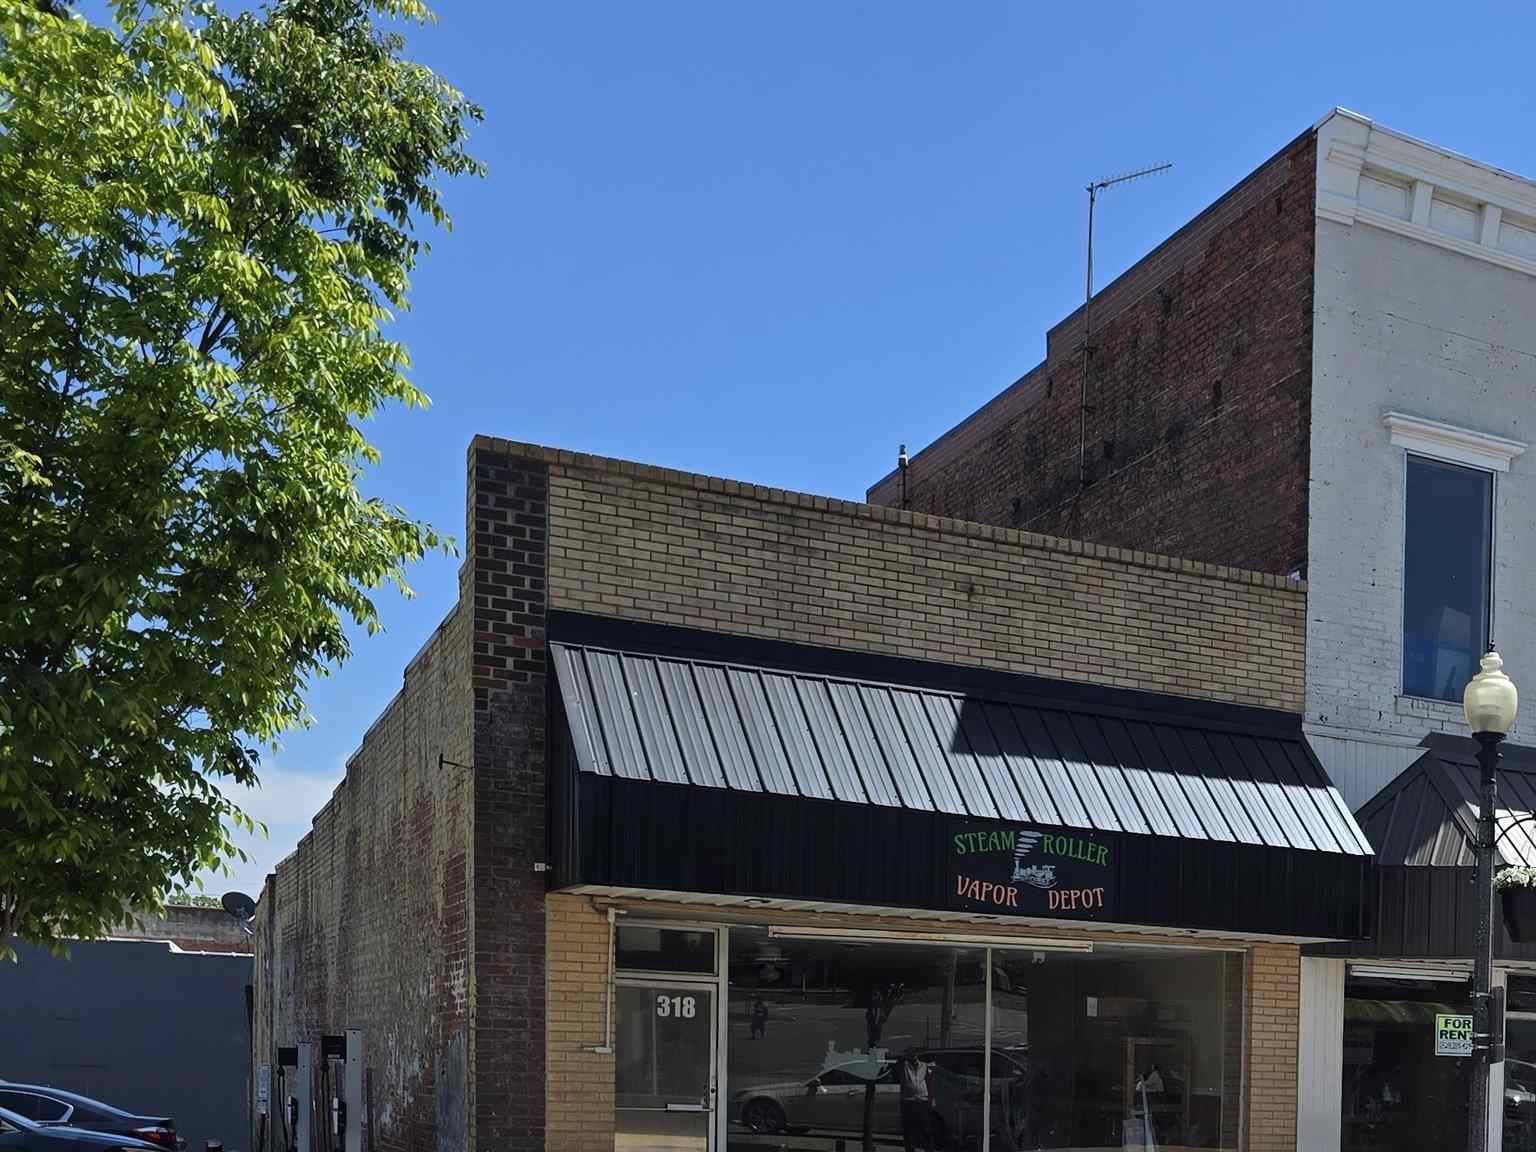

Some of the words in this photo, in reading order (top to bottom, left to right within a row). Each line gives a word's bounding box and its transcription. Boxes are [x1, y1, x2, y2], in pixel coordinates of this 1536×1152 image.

[954, 830, 1016, 855] STEAM
[1042, 834, 1109, 867] ROLLER
[956, 874, 1018, 907] VAPOR
[1048, 887, 1105, 910] DEPOT
[656, 995, 696, 1018] 318
[1444, 1018, 1472, 1029] FOR
